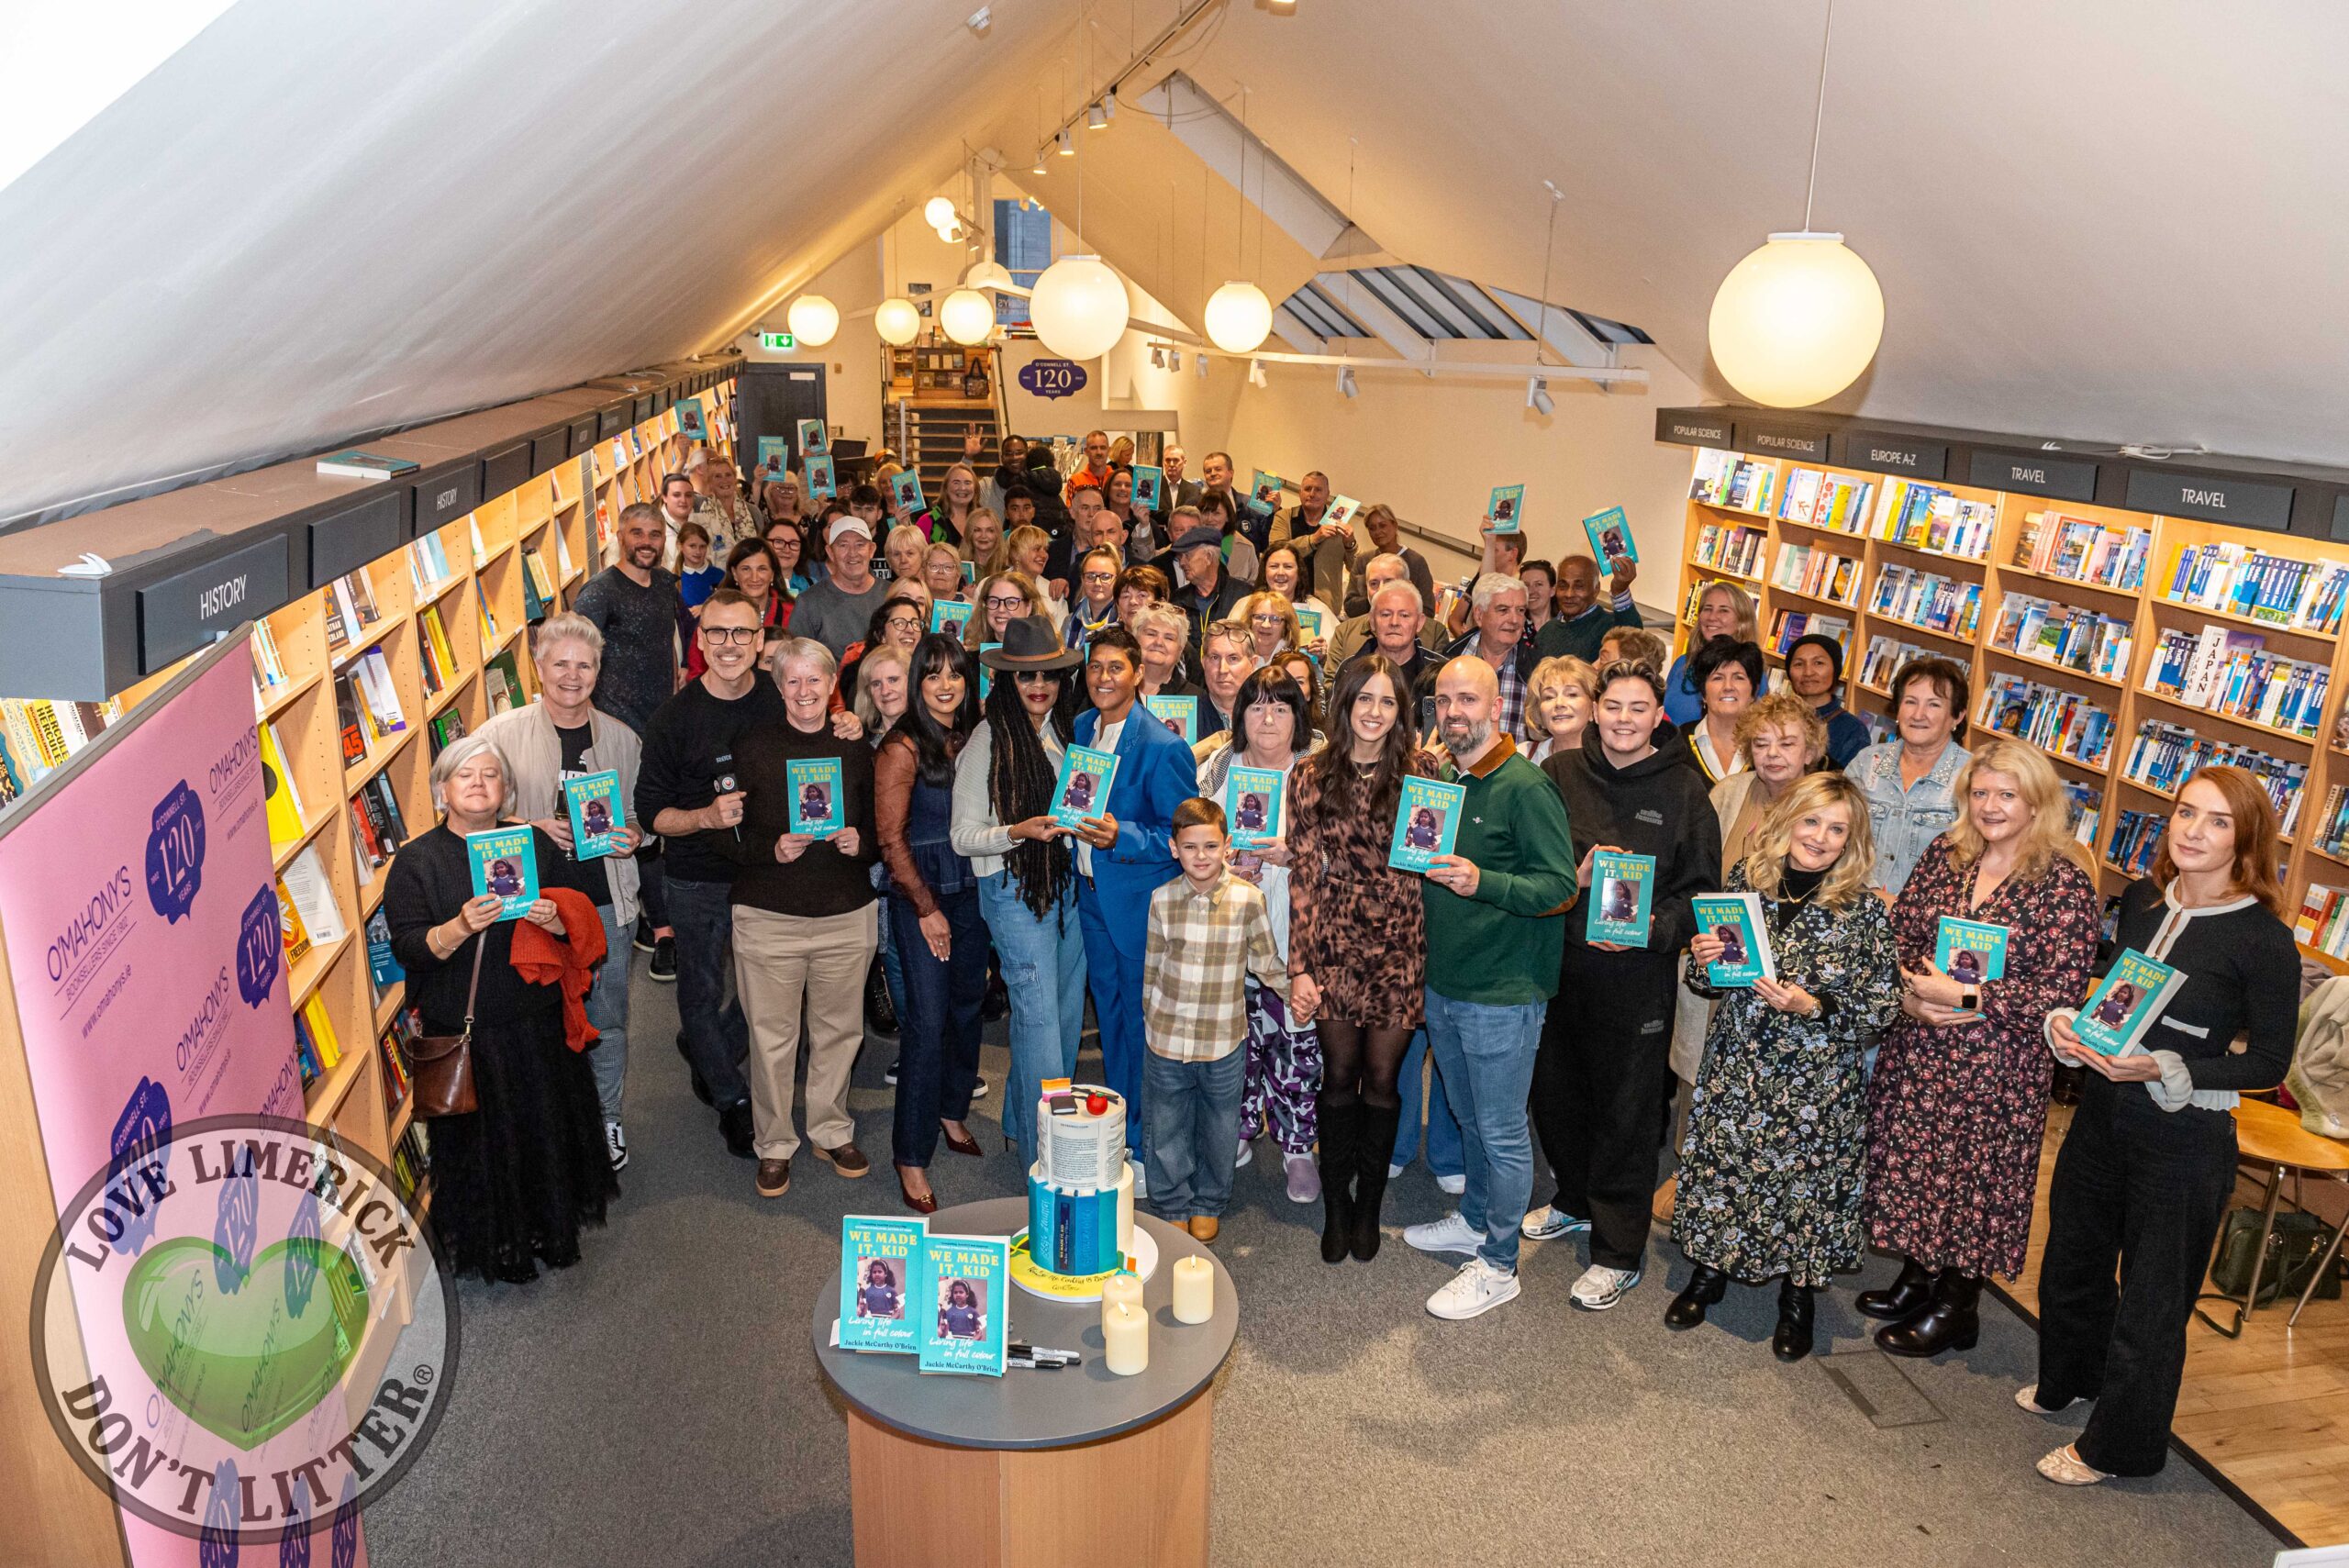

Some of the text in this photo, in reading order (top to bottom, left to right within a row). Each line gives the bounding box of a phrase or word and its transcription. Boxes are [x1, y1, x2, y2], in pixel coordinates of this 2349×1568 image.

[1035, 369, 1072, 388] 120
[1674, 425, 1721, 439] POPULAR SCIENCE
[1757, 435, 1815, 451] POPULAR SCIENCE
[1871, 449, 1916, 466] EUROPE A-Z
[2011, 466, 2046, 484] TRAVEL
[437, 487, 458, 511] HISTORY
[2181, 487, 2227, 509] TRAVEL
[201, 574, 247, 620] HISTORY
[2197, 638, 2220, 693] JAPAN
[1167, 702, 1194, 710] MADE
[209, 725, 258, 794] O'MAHONY'S
[1085, 755, 1112, 768] MADE
[1087, 764, 1104, 773] KID
[571, 785, 584, 794] WE
[588, 779, 614, 790] MADE
[593, 788, 609, 796] KID
[1408, 785, 1457, 803] WE MADE
[1412, 795, 1449, 808] IT, KID
[155, 803, 181, 830] O'CONNELL
[473, 843, 492, 851] WE
[495, 837, 529, 848] MADE
[482, 846, 522, 859] IT, KID
[160, 815, 195, 895] 120
[1598, 860, 1651, 872] WE MADE
[1605, 869, 1642, 880] IT, KID
[178, 883, 193, 903] YEARS
[1698, 906, 1745, 915] WE MADE
[1706, 915, 1720, 923] IT,
[48, 865, 131, 982] O'MAHONY'S
[1945, 927, 2001, 944] WE MADE
[246, 912, 273, 984] 120
[291, 938, 311, 961] FREEDOM
[1970, 940, 1993, 951] KID
[66, 947, 102, 1001] BOOKSELLERS
[102, 929, 117, 955] SINCE
[2122, 958, 2167, 984] WE MADE
[2121, 969, 2154, 989] IT, KID
[82, 964, 132, 1040] www.omahonys.ie
[176, 966, 228, 1072] O'MAHONY'S
[115, 1108, 140, 1154] O'CONNELL
[225, 1178, 252, 1268] 120
[850, 1231, 917, 1245] WE MADE
[858, 1244, 907, 1256] IT, KID
[930, 1251, 998, 1266] WE MADE
[939, 1263, 989, 1277] IT, KID
[873, 1329, 887, 1340] full
[954, 1350, 969, 1361] full
[946, 1362, 974, 1371] McCarthy
[976, 1364, 998, 1373] O'Brien
